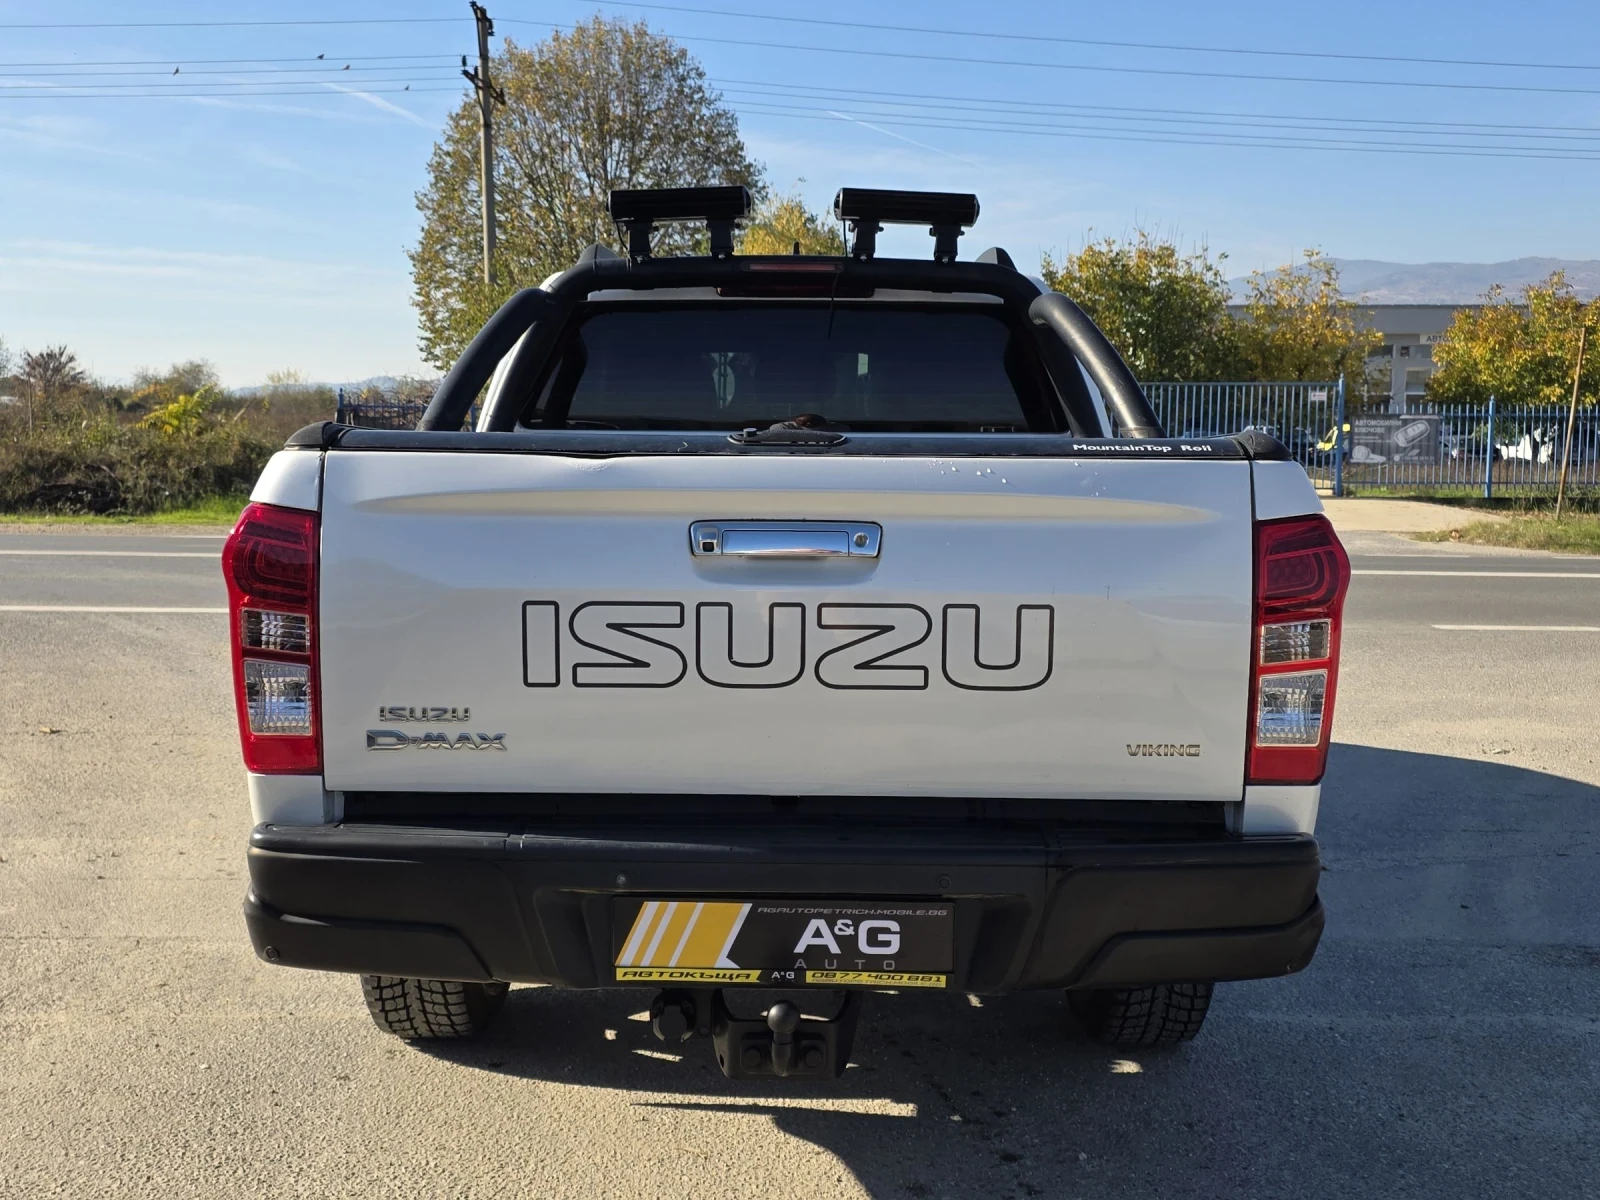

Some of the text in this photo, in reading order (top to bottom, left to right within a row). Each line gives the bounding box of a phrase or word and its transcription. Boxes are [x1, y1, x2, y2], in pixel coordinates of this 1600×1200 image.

[1072, 443, 1212, 453] MountainTop Roll
[521, 600, 1055, 691] ISUZU
[379, 706, 470, 723] ISUZU
[366, 729, 507, 751] D-MAX
[1126, 744, 1200, 757] VIKING
[757, 907, 948, 916] AGAUTOPETRICH.MOBILE.BG
[793, 918, 901, 955] A&G
[793, 958, 896, 971] AUTO
[621, 970, 752, 981] АВТОКЪЩА
[811, 971, 943, 983] 0877 400 881
